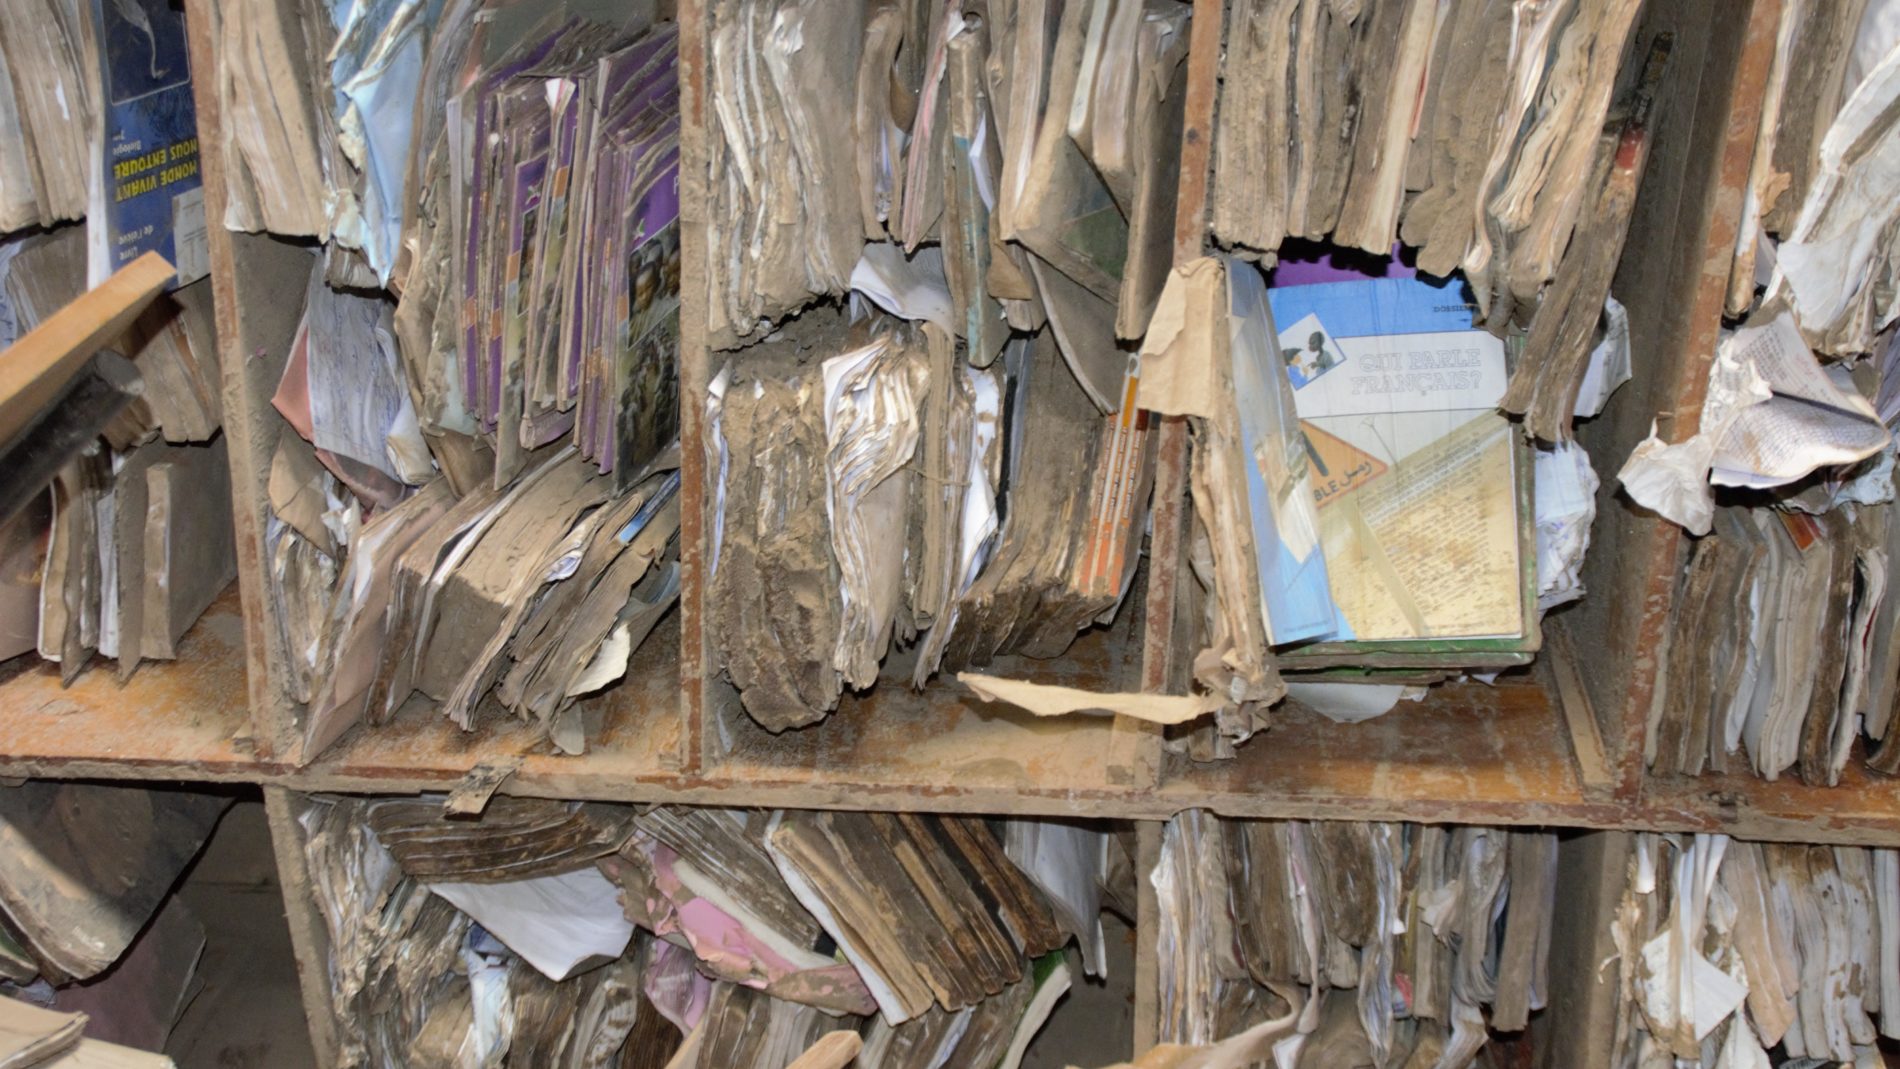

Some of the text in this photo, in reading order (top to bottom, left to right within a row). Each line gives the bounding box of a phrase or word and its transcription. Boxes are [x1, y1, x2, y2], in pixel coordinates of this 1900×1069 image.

[114, 139, 198, 179] NOUS ENTOURE
[116, 160, 198, 202] MONDE VIVANT
[1360, 349, 1481, 373] QUI PARLE
[1350, 370, 1481, 396] FRANÇAIS?
